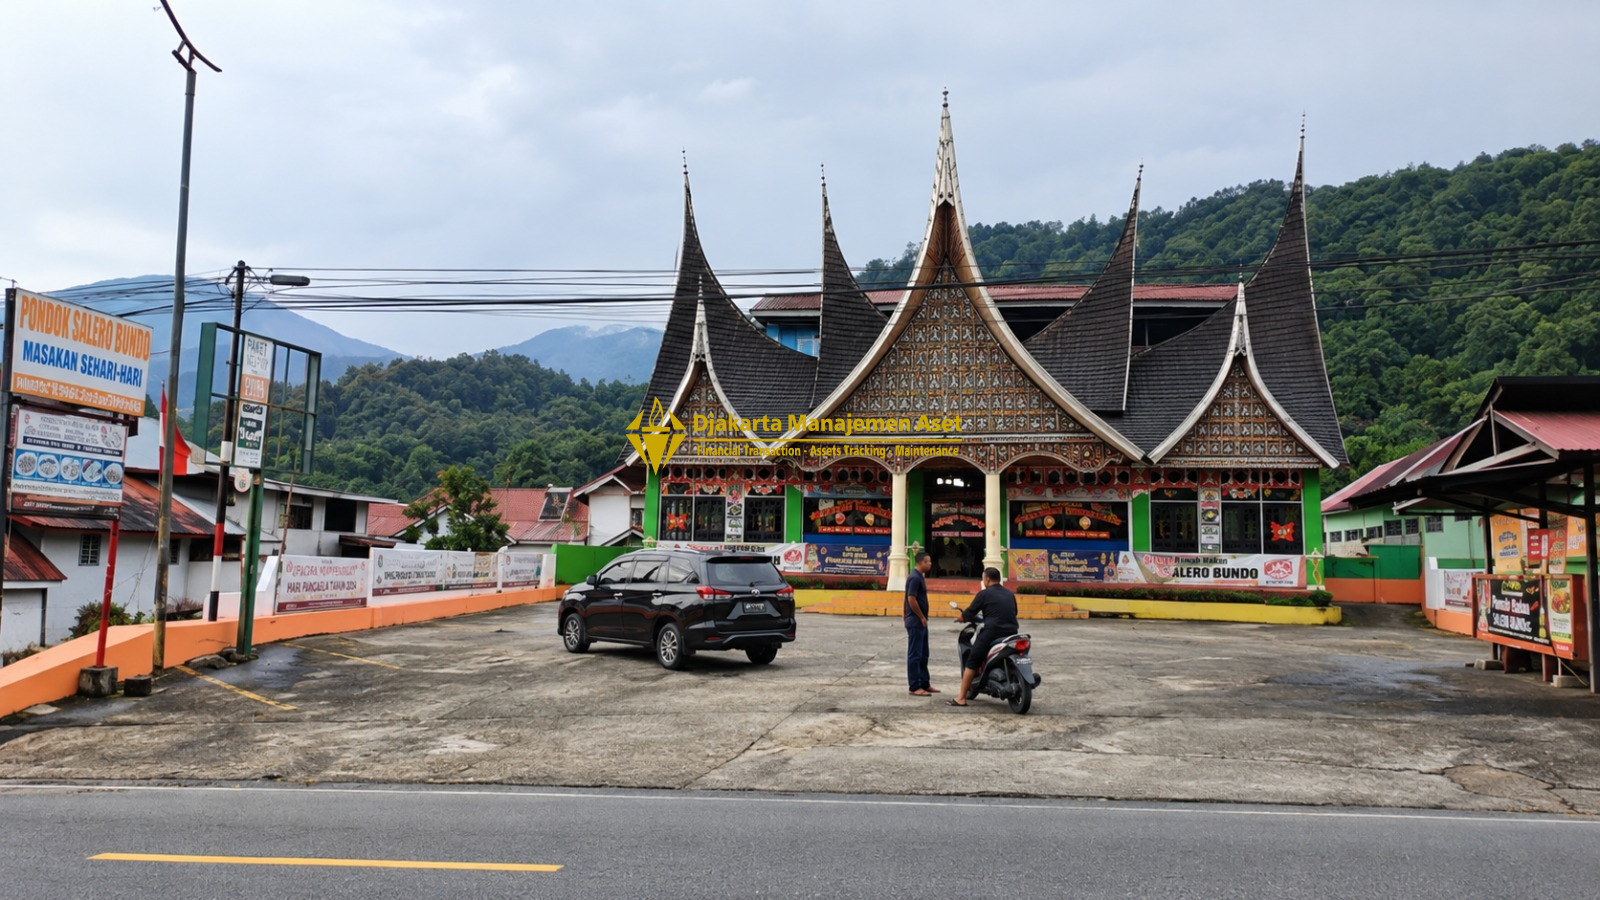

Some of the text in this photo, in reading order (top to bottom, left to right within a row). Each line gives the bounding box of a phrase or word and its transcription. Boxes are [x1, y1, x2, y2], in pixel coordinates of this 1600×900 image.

[20, 295, 151, 361] PONDOK SALERO BUNDO
[23, 340, 143, 387] MASAKAN SEHARI-HARI
[1213, 567, 1259, 580] BUNDO
